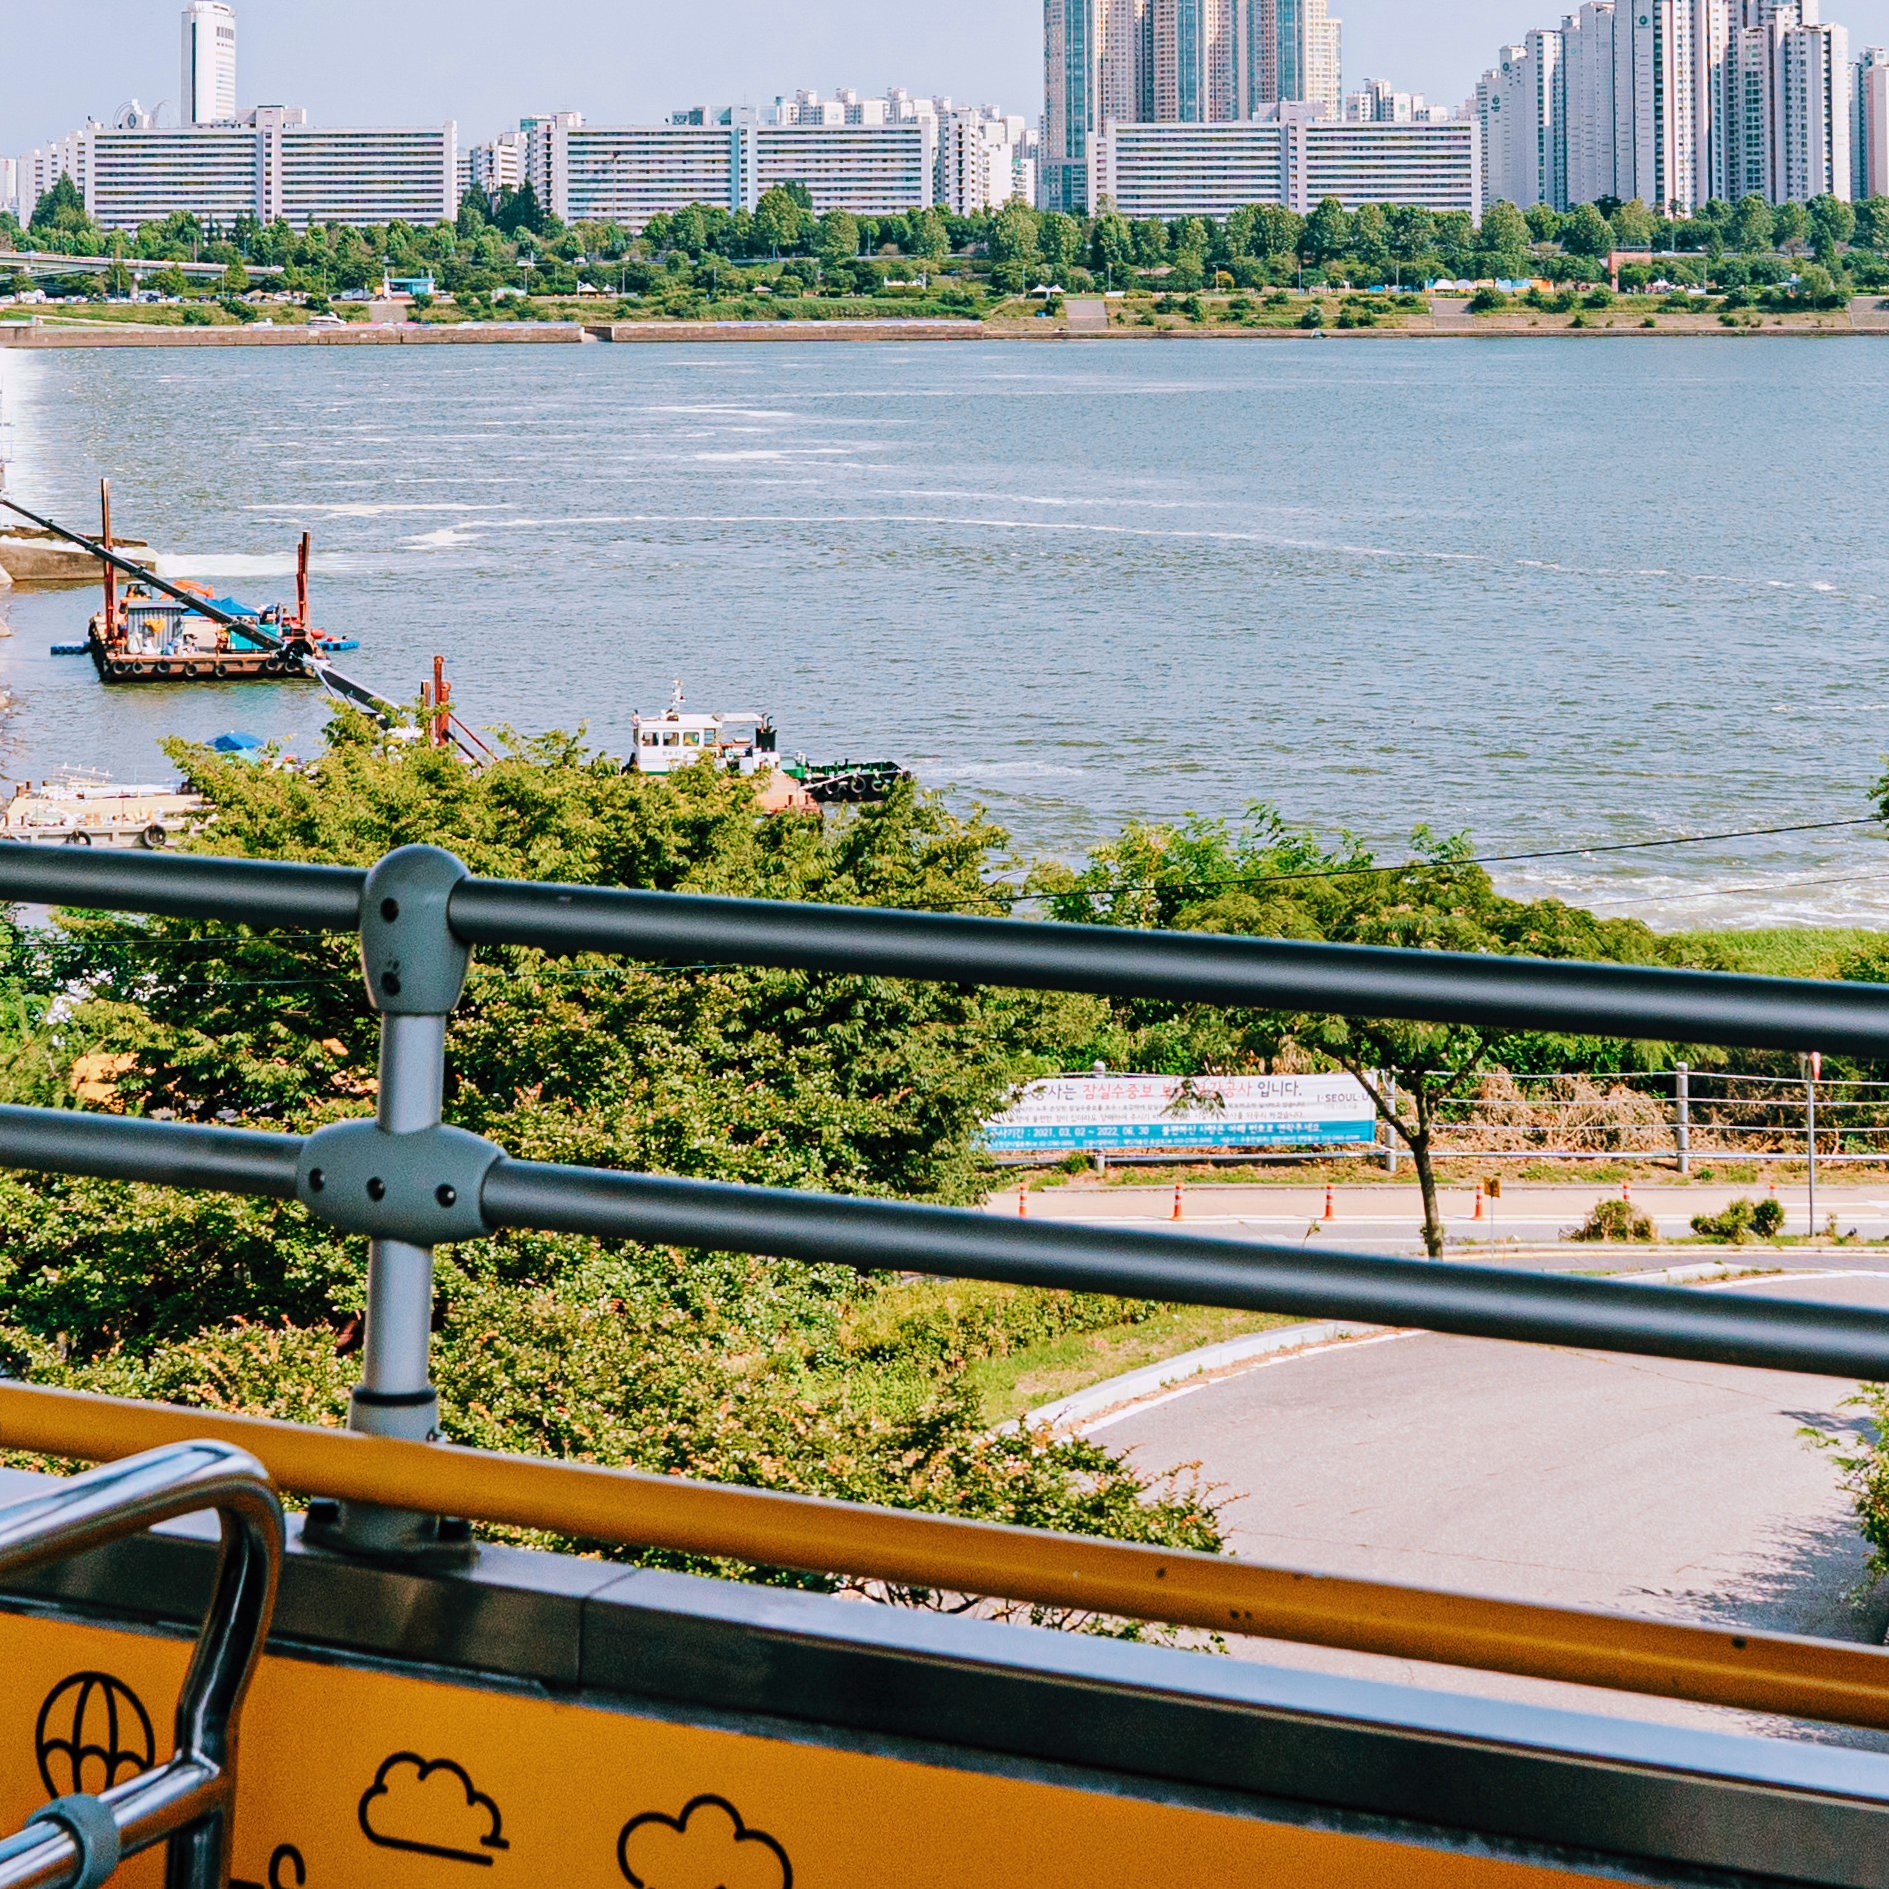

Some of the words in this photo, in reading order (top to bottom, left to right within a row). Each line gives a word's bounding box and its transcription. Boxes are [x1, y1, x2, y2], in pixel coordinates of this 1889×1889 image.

[1083, 1084, 1153, 1100] 잠실수중보
[1258, 1081, 1302, 1097] 입니다.
[1033, 1127, 1056, 1137] 2021.
[1059, 1127, 1072, 1137] 03.
[1075, 1127, 1086, 1137] 02
[1097, 1126, 1119, 1136] 2022.
[1139, 1126, 1149, 1135] 30
